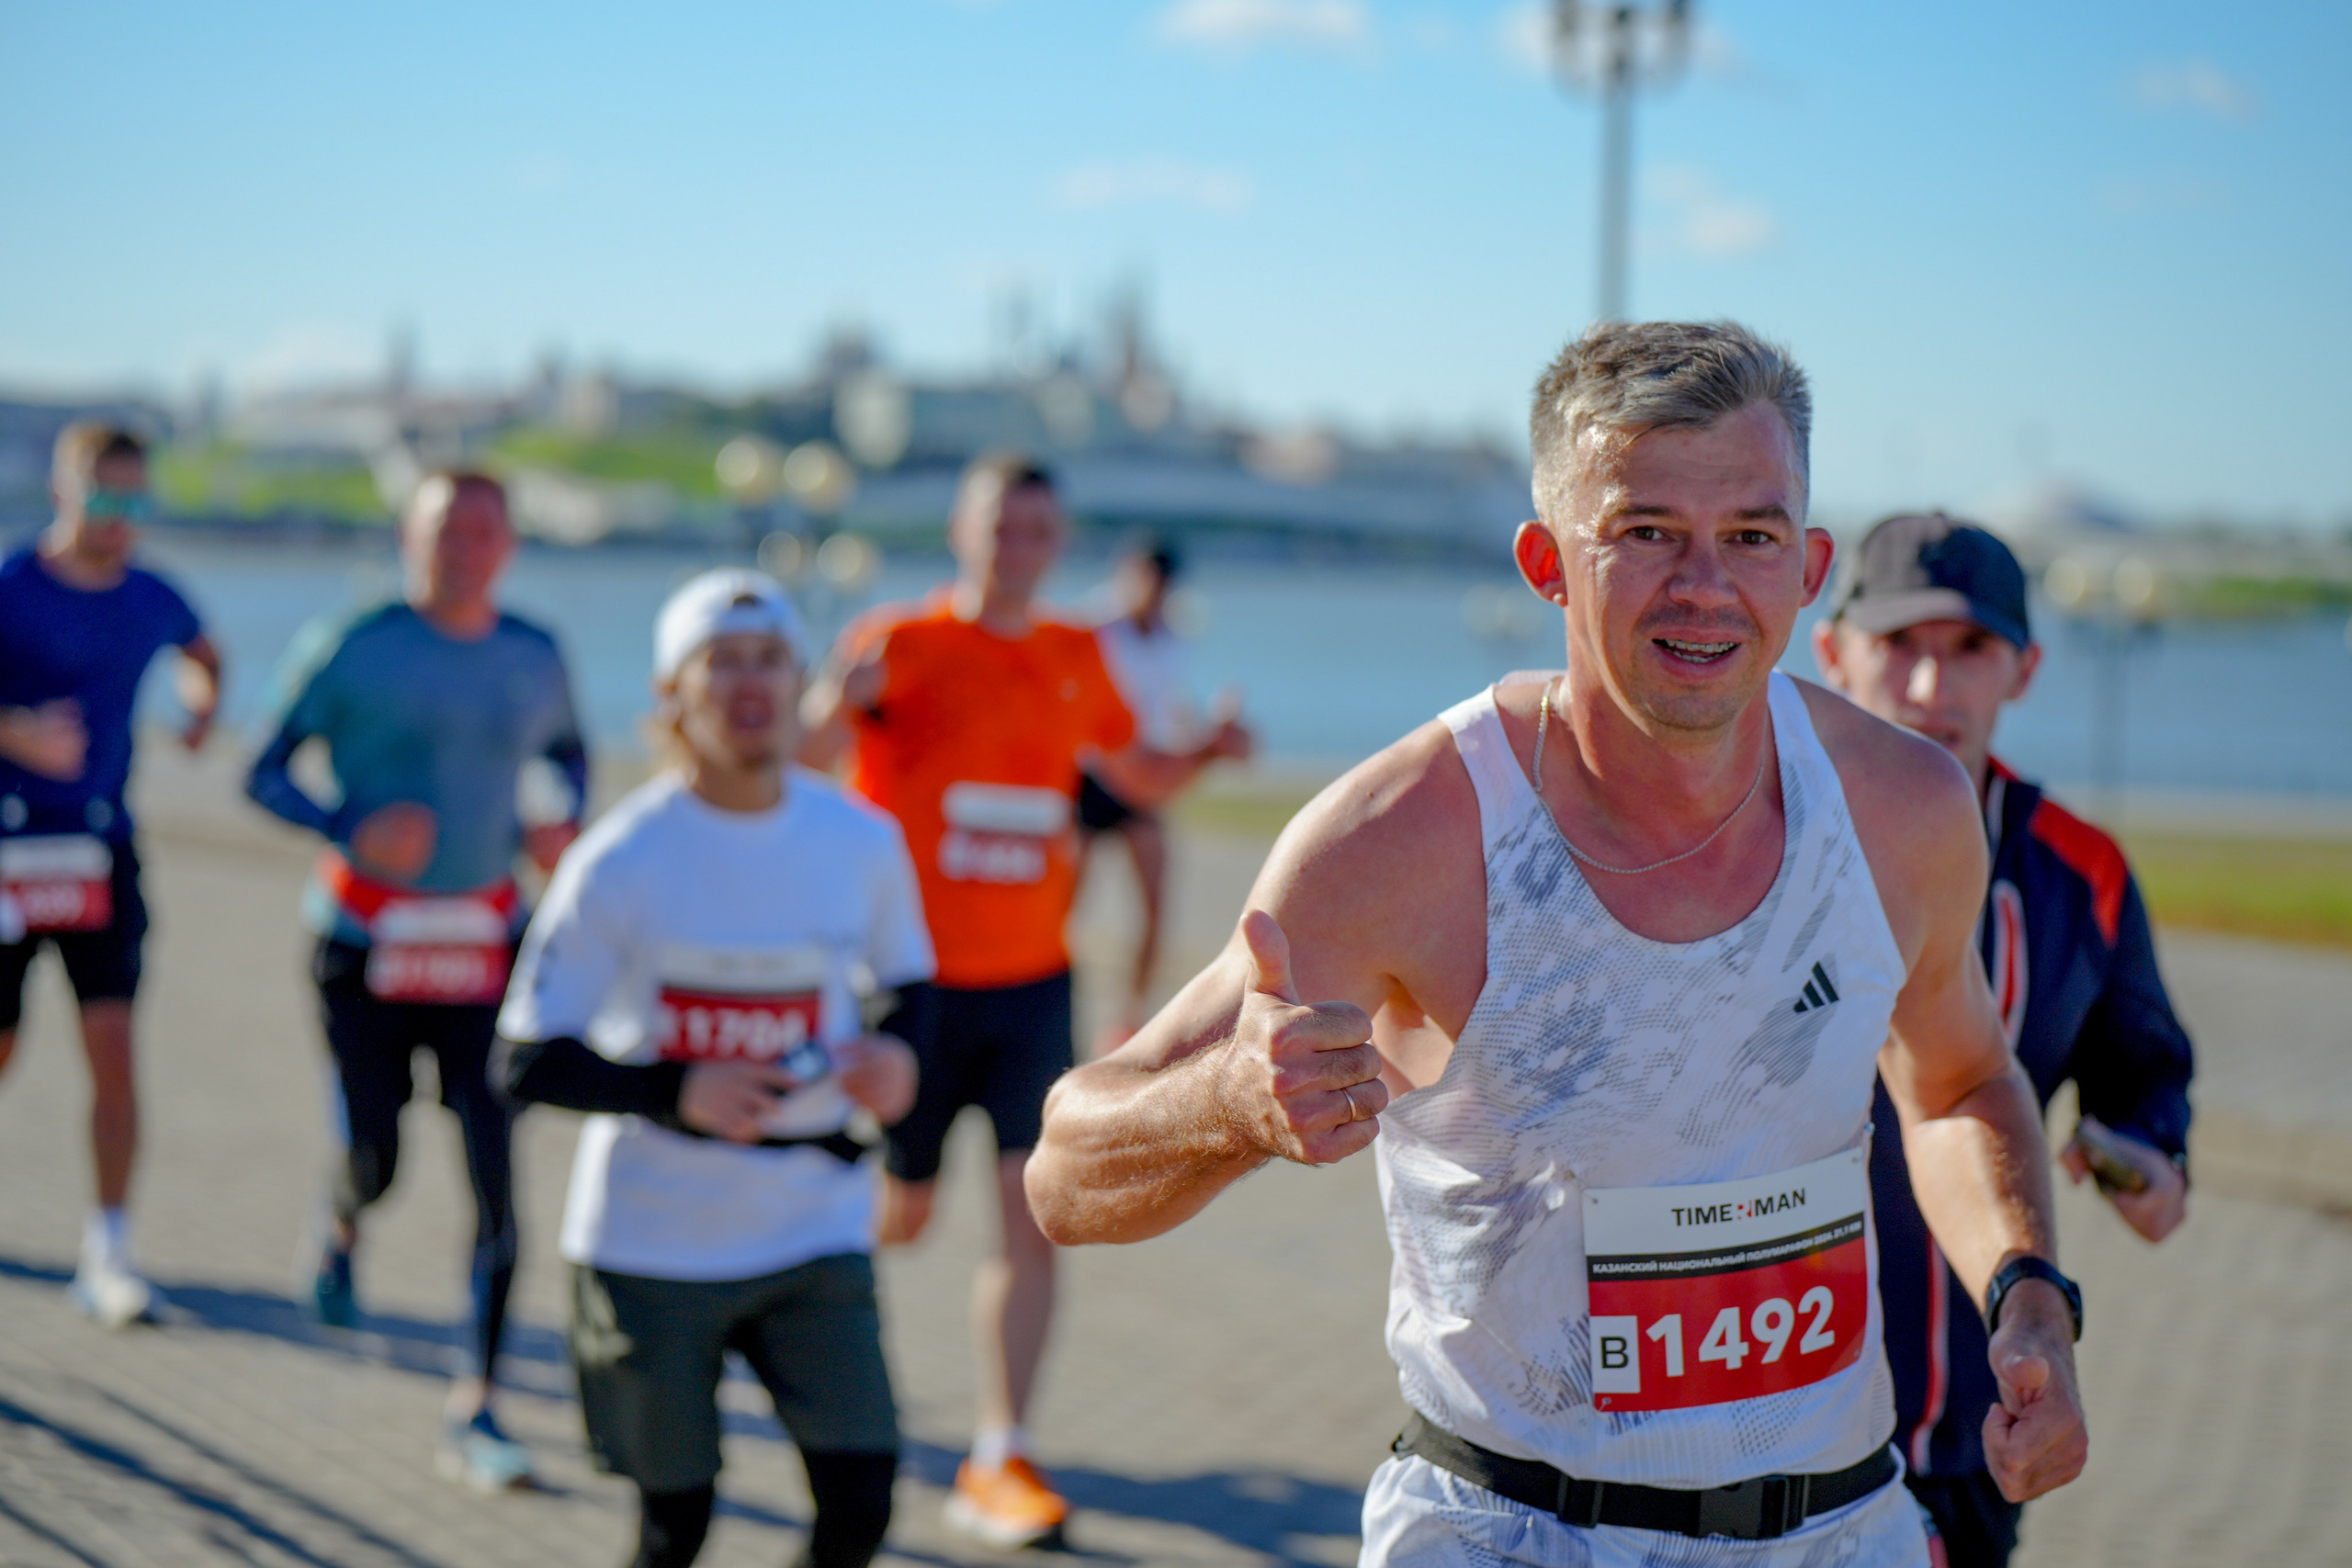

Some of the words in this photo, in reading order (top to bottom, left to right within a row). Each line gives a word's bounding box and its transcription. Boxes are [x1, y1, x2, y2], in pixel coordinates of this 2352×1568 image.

[1592, 1259, 1657, 1273] КАЗАНСКИЙ
[1658, 1251, 1745, 1272] НАЦИОНАЛЬНЫЙ
[1746, 1237, 1814, 1262] ПОЛУМАРАФОН
[1645, 1285, 1836, 1378] 1492
[1600, 1336, 1629, 1369] B
